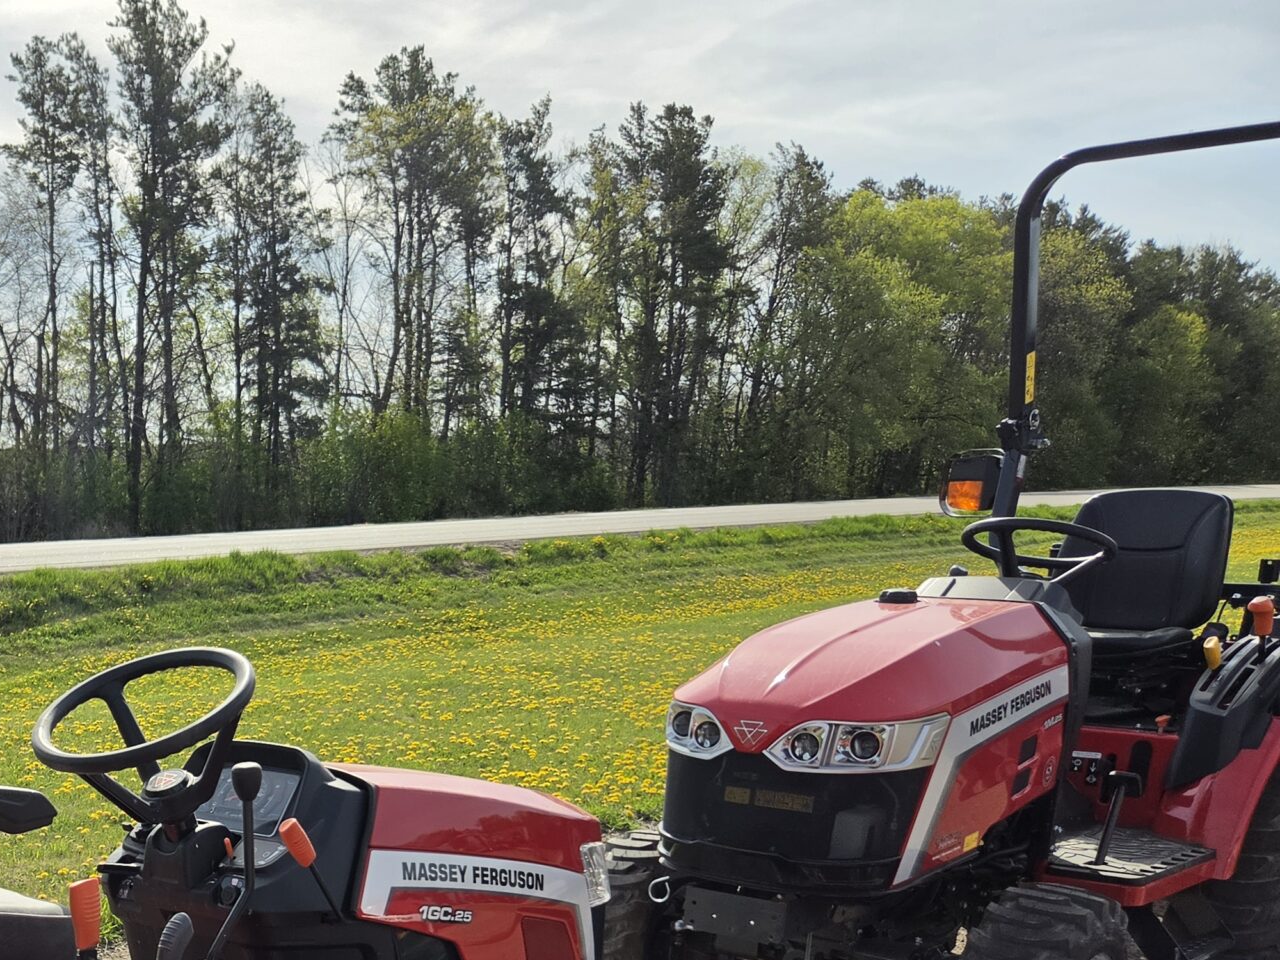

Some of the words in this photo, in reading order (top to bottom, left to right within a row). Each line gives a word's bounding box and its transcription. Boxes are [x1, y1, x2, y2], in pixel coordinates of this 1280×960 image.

[970, 702, 1009, 736] MASSEY
[1010, 680, 1052, 715] FERGUSON
[401, 862, 468, 883] MASSEY
[472, 866, 544, 891] FERGUSON
[419, 905, 472, 922] 1GC.25
